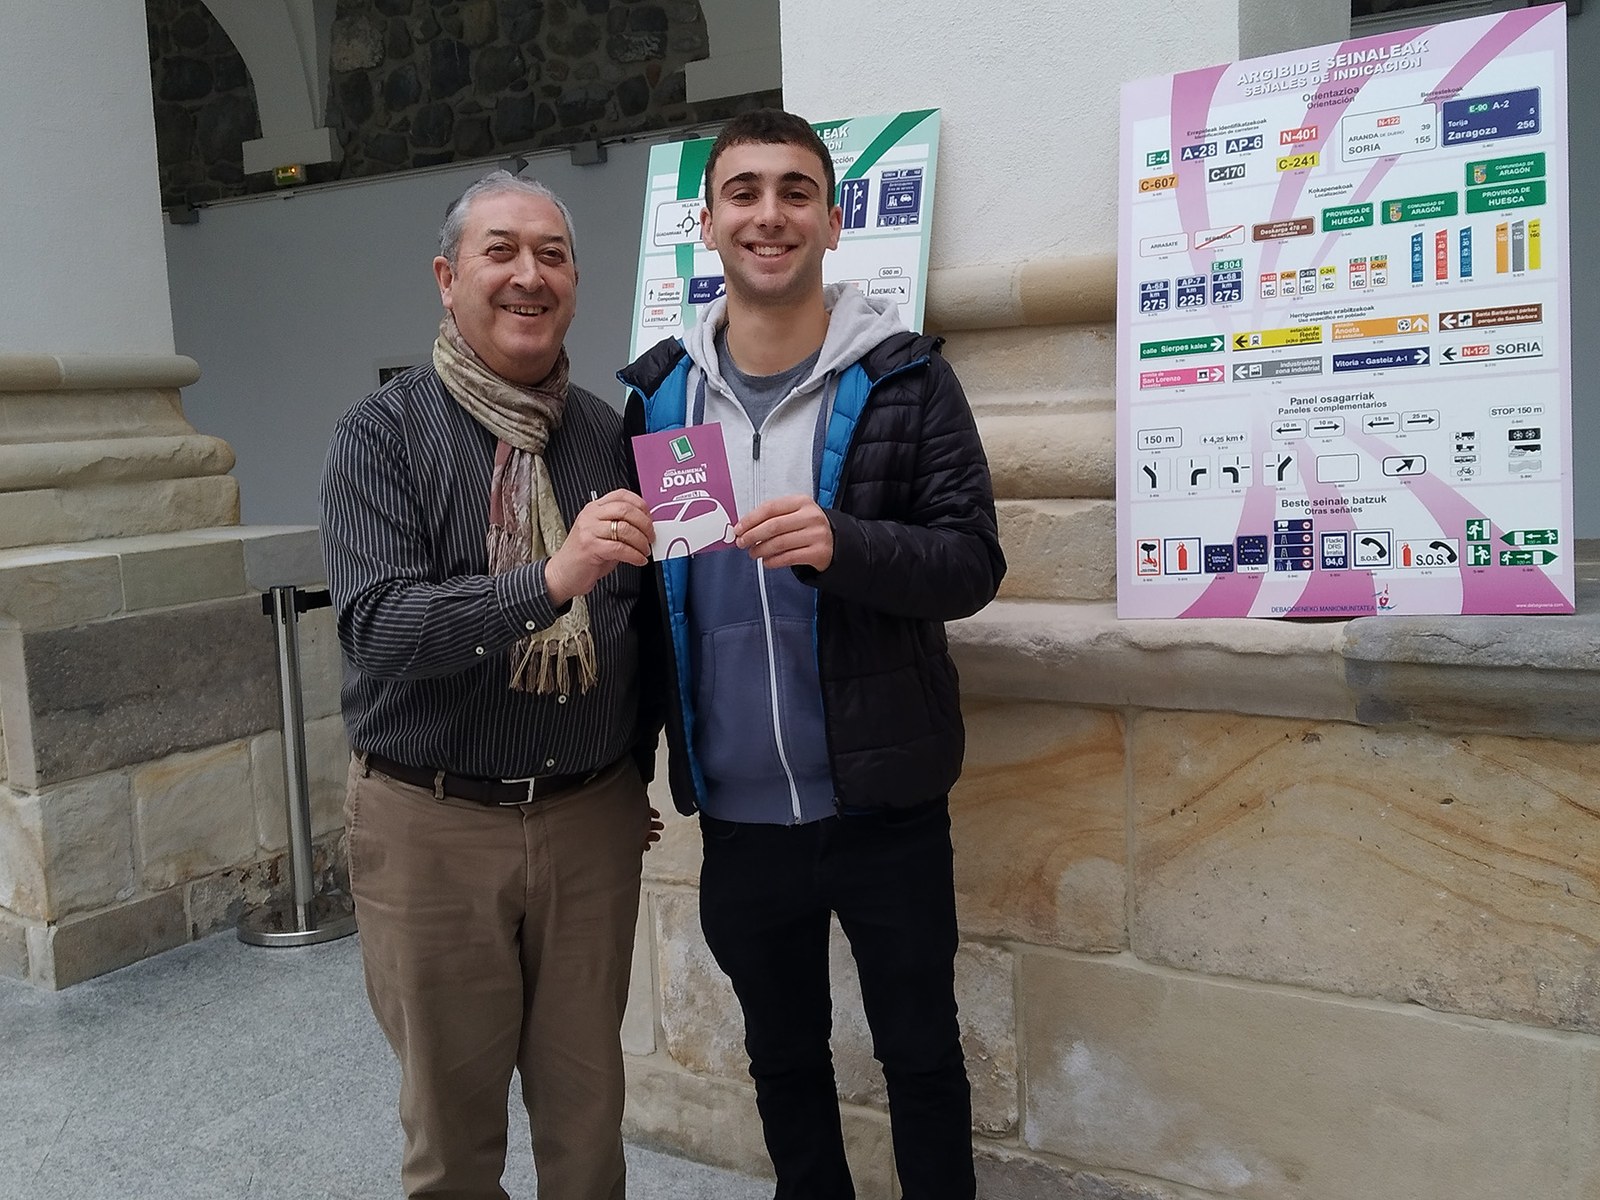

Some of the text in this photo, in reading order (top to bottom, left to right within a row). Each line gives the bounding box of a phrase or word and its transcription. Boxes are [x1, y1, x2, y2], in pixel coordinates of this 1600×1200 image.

[1236, 39, 1429, 87] ARGIBIDE SEINALEAK
[1244, 56, 1422, 97] SEÑALES DE INDICACIÓN
[1302, 86, 1360, 103] Orientazioa
[1307, 96, 1355, 110] Orientación
[1469, 100, 1510, 113] E-90 A-2
[1378, 117, 1399, 126] N-122
[1448, 119, 1468, 128] Torija
[1516, 120, 1535, 130] 256
[1282, 128, 1317, 143] N-401
[1348, 132, 1378, 143] ARANDA
[1448, 127, 1497, 141] Zaragoza
[1227, 136, 1262, 153] AP-6
[1415, 136, 1431, 144] 155
[1182, 144, 1216, 160] A-28
[1349, 143, 1381, 155] SORIA
[1148, 152, 1169, 165] E-4
[1278, 155, 1316, 170] C-241
[1211, 166, 1244, 181] C-170
[1499, 166, 1531, 176] ARAGÓN
[1141, 177, 1175, 191] C-607
[1482, 188, 1519, 198] PROVINCIA
[1488, 195, 1524, 206] HUESCA
[1325, 209, 1360, 218] PROVINCIA
[1411, 206, 1441, 215] ARAGÓN
[1331, 215, 1365, 226] HUESCA
[1150, 241, 1178, 249] ARRASATE
[1213, 260, 1241, 271] E-804
[1181, 278, 1201, 286] AP-7
[1218, 273, 1237, 281] A-68
[1146, 282, 1164, 290] A-68
[1179, 295, 1203, 306] 225
[1215, 291, 1240, 302] 275
[1143, 299, 1167, 311] 275
[1143, 346, 1157, 355] calle
[1161, 344, 1189, 353] Sierpes
[1463, 342, 1541, 356] N-122 SORIA
[1335, 357, 1359, 368] Vitoria
[1366, 356, 1394, 365] Gasteiz
[1396, 355, 1408, 363] A-1
[1291, 365, 1320, 373] industrial
[1290, 391, 1375, 406] Panel osagarriak
[1278, 400, 1388, 415] Paneles complementarios
[1491, 408, 1515, 416] STOP
[1144, 435, 1175, 444] 150 m
[1209, 435, 1224, 444] 4,25
[663, 472, 706, 488] DOAN
[1281, 496, 1387, 508] Beste seinale batzuk
[1330, 506, 1363, 514] señales
[1325, 558, 1344, 566] 94,6
[1415, 554, 1447, 566] S.O.S.
